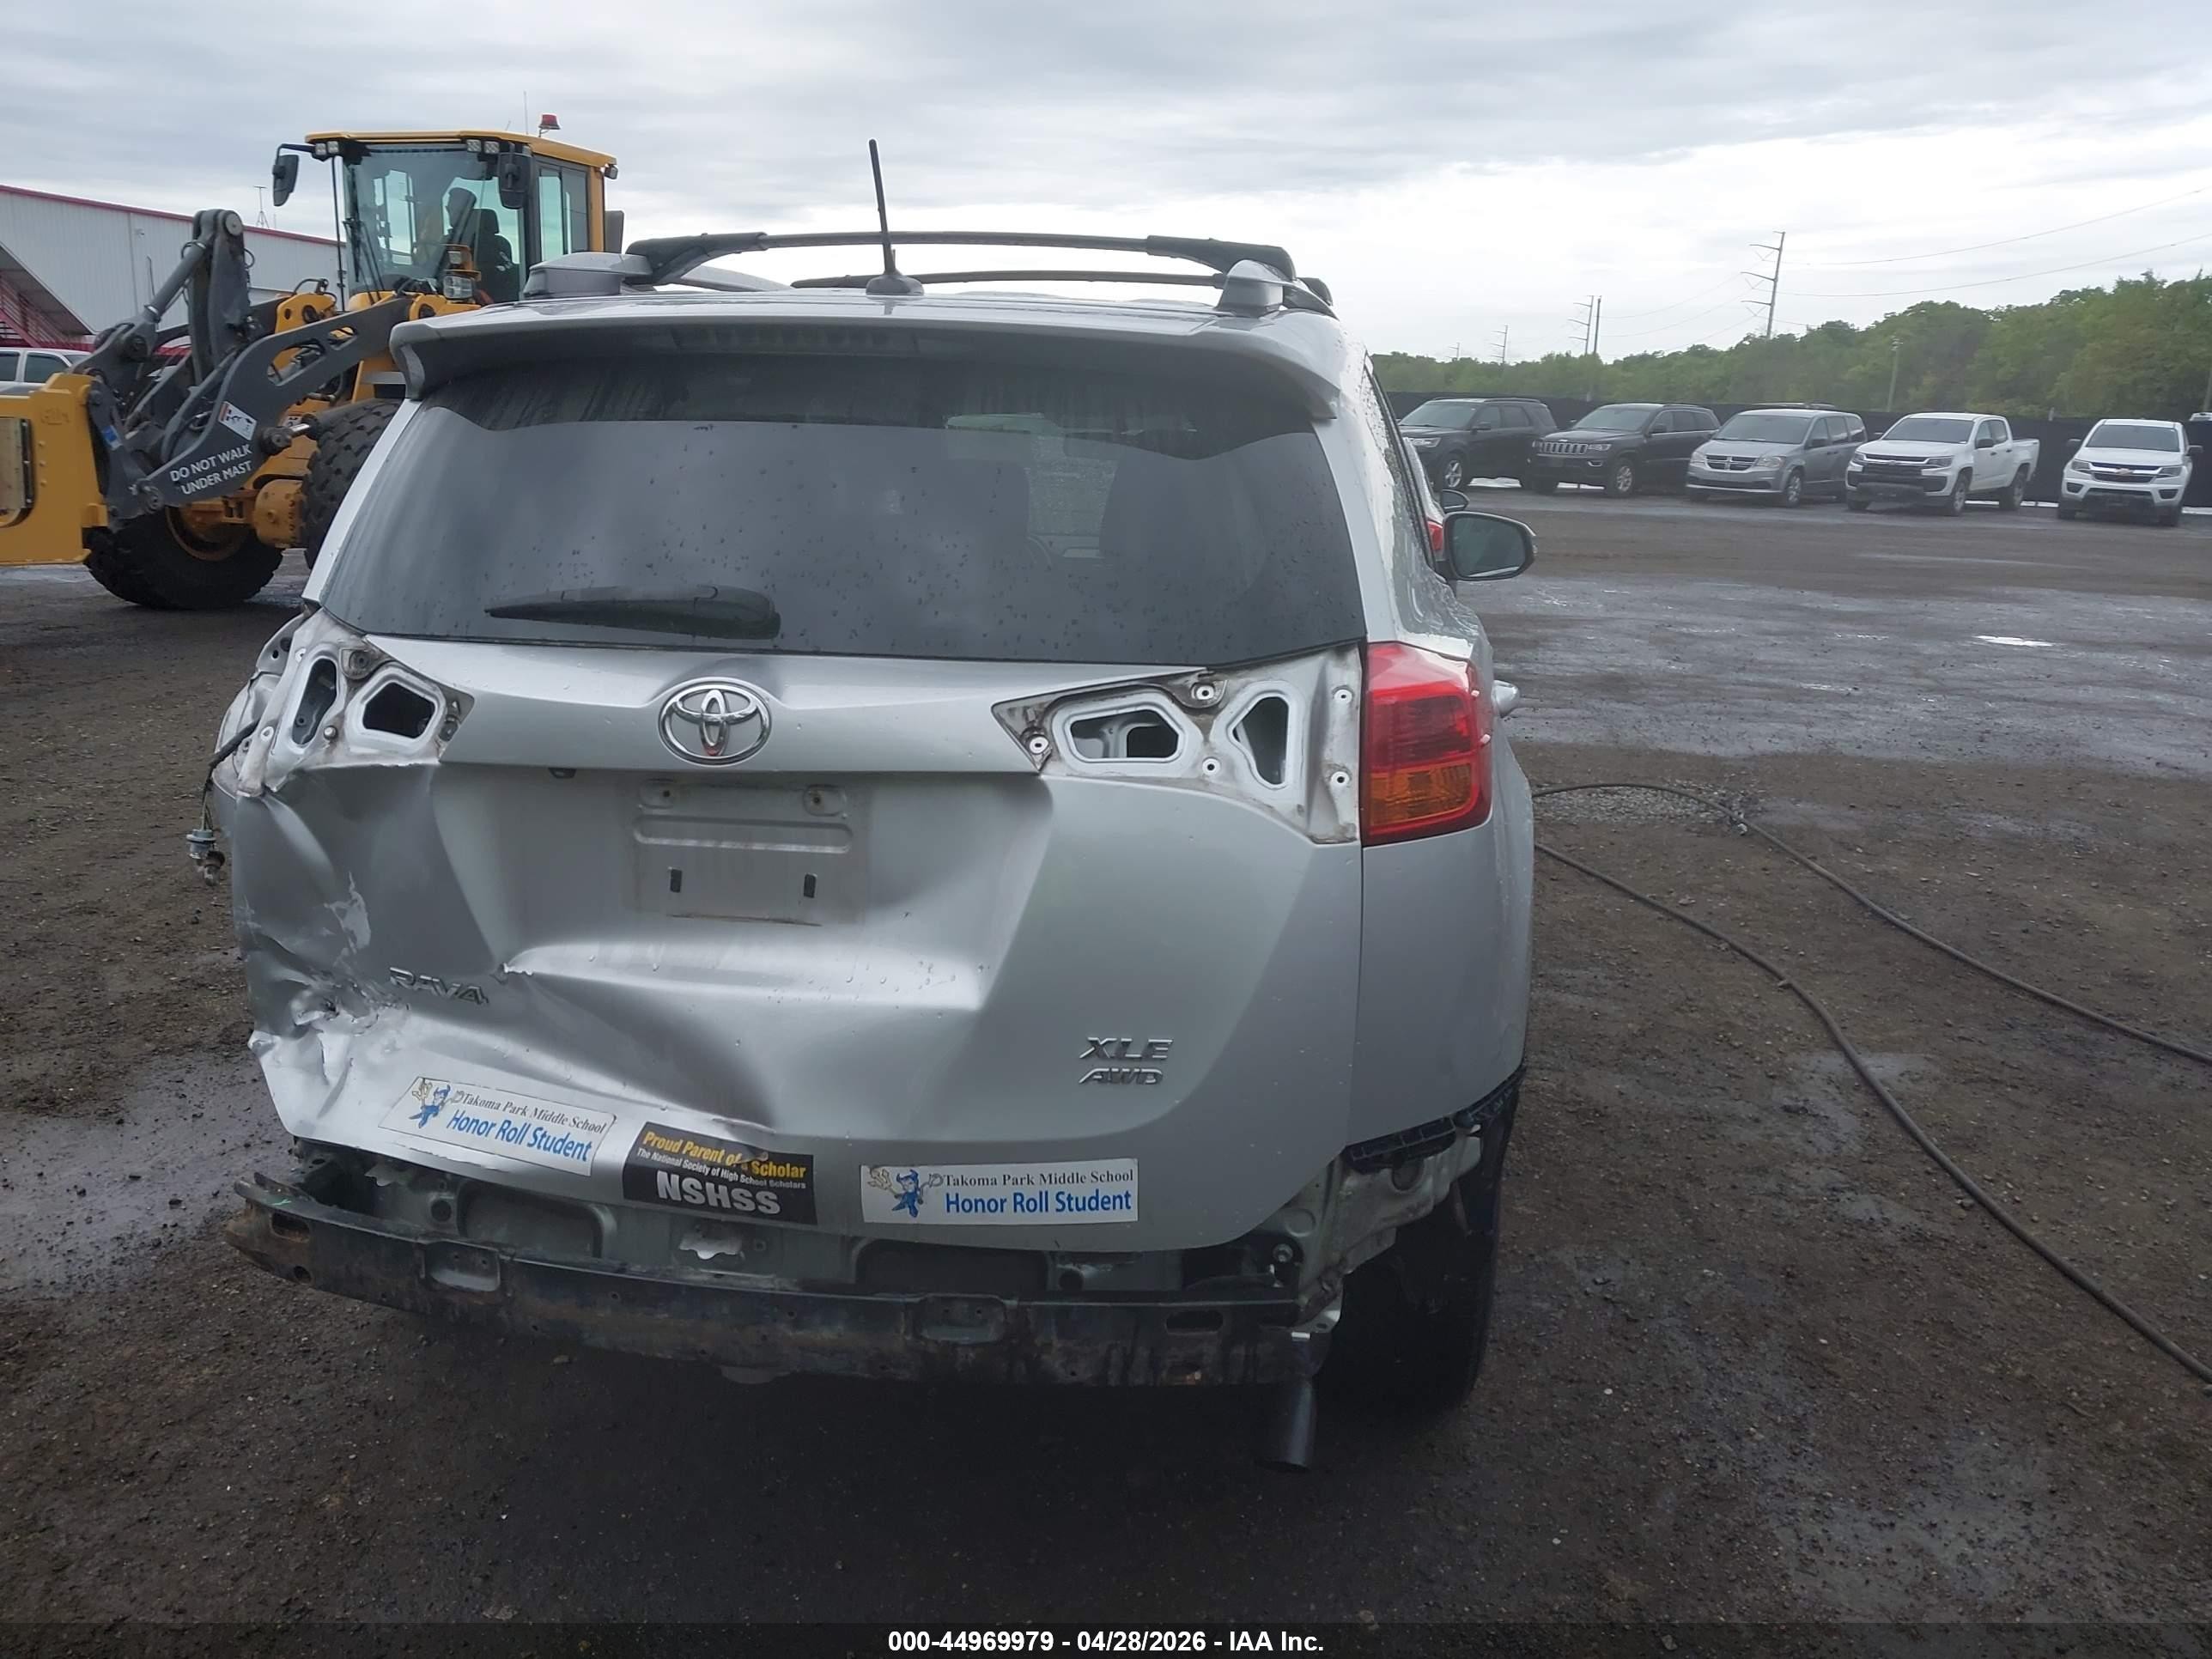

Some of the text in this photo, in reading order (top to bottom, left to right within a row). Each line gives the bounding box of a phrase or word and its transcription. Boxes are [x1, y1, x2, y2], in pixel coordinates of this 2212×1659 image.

[170, 444, 252, 481] DO NOT WALK
[181, 460, 252, 495] UNDER MAST
[1079, 1036, 1173, 1060] XLE
[1079, 1067, 1164, 1085] AWD
[462, 1092, 607, 1134] Takoma Park Middle School
[447, 1109, 592, 1162] Honor Roll Student
[637, 1147, 806, 1189] The National Society of High School Scholars
[642, 1131, 684, 1154] Proud
[682, 1140, 726, 1164] Parent
[750, 1159, 806, 1179] Scholar
[656, 1170, 781, 1214] NSHSS
[945, 1169, 1134, 1187] Takoma Park Middle School
[945, 1188, 1132, 1213] Honor Roll Student
